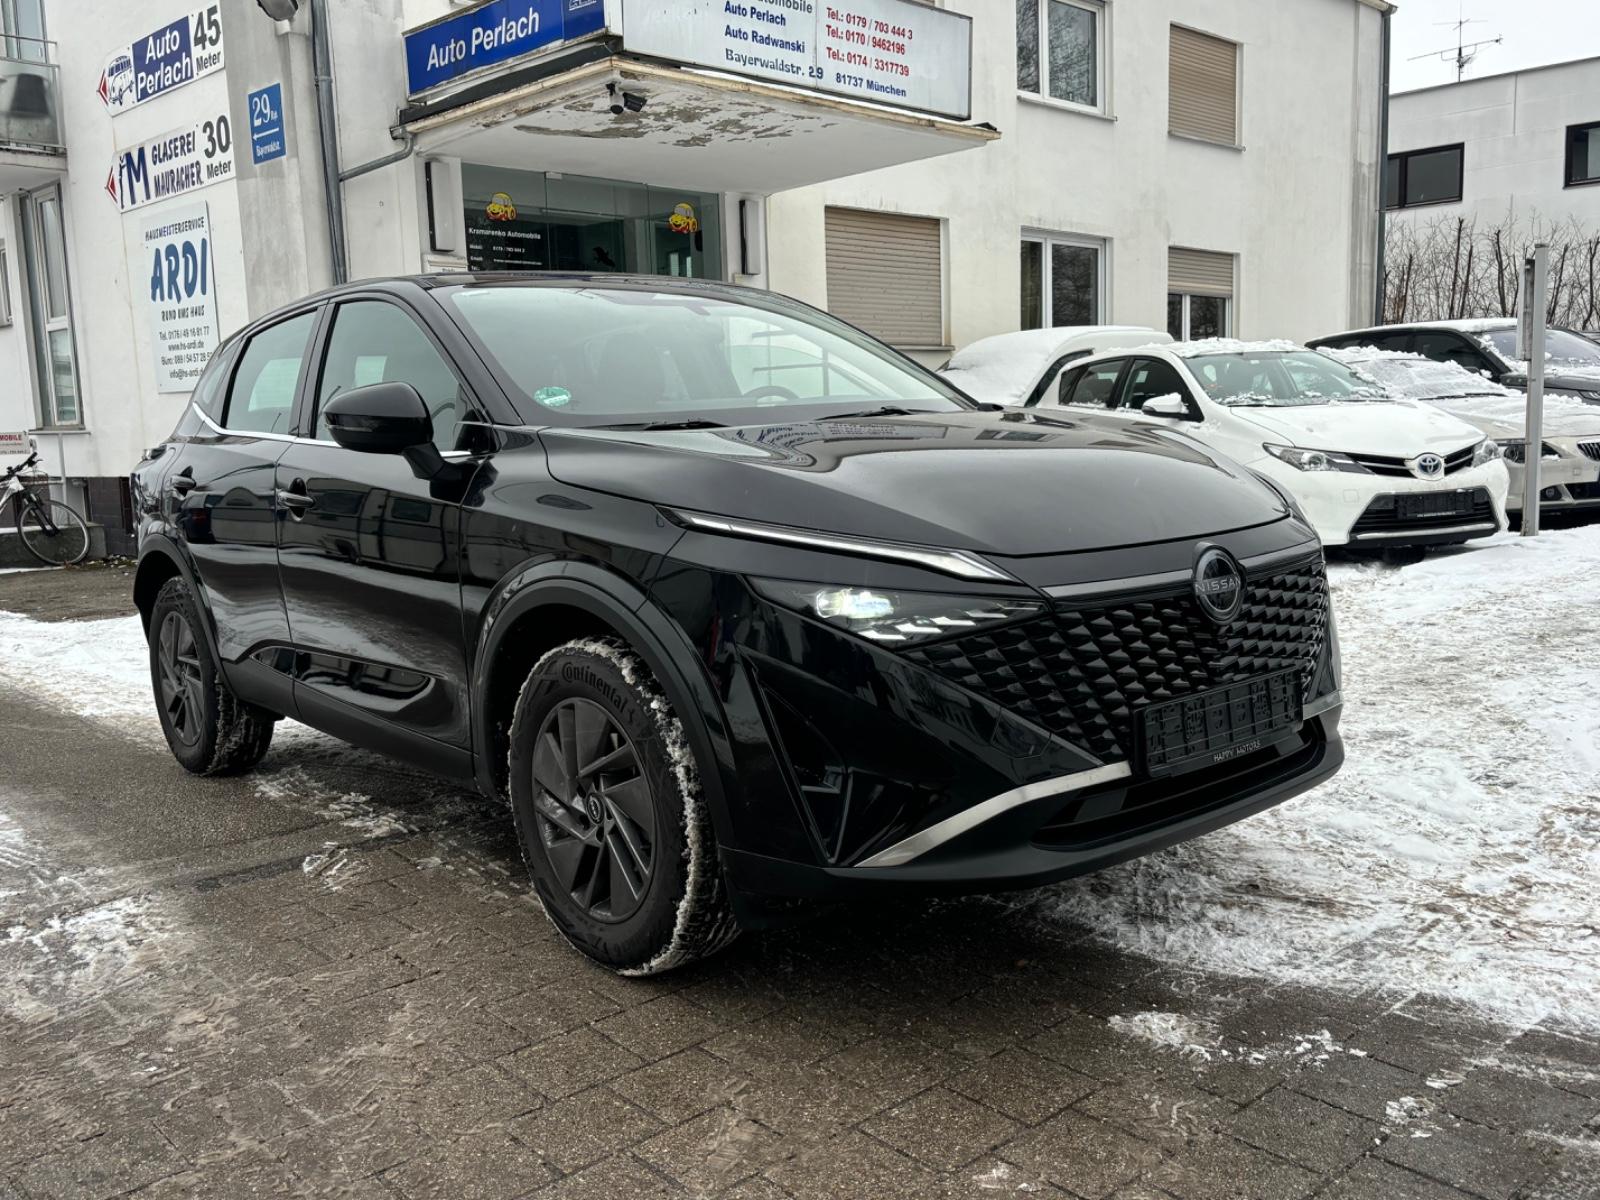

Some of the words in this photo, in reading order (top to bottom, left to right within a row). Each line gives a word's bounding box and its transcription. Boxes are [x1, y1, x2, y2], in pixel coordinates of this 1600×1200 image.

[194, 5, 220, 50] 45
[725, 0, 747, 17] Auto
[750, 6, 786, 26] Perlach
[826, 7, 844, 22] Tel.:
[846, 13, 866, 28] 0179
[868, 18, 872, 30] /
[874, 21, 889, 34] 703
[891, 26, 906, 38] 444
[907, 30, 912, 40] 3
[145, 28, 180, 64] Auto
[427, 38, 466, 71] Auto
[472, 7, 539, 56] Perlach
[725, 24, 748, 40] Auto
[752, 30, 805, 53] Radwanski
[826, 25, 843, 40] Tel.:
[846, 30, 866, 45] 0170
[867, 35, 870, 46] /
[872, 36, 905, 55] 9462196
[138, 52, 192, 99] Perlach
[196, 51, 221, 72] Meter
[725, 48, 804, 76] Bayerwaldstr.
[808, 66, 823, 79] 29
[836, 72, 863, 88] 81737
[866, 79, 906, 97] München
[826, 47, 844, 62] Tel.:
[847, 52, 867, 67] 0174
[870, 57, 872, 68] /
[874, 58, 909, 76] 3317739
[252, 94, 270, 127] 29
[152, 131, 195, 166] GLASEREI
[202, 115, 230, 158] 30
[154, 160, 202, 198] MAURACHER
[206, 161, 231, 179] Meter
[146, 216, 204, 241] HAUSMEISTERSERVICE
[151, 238, 207, 304] ARDI
[162, 310, 176, 322] RUND
[190, 304, 204, 318] HAUS
[1194, 578, 1240, 593] NISSAN
[562, 662, 628, 713] Continental
